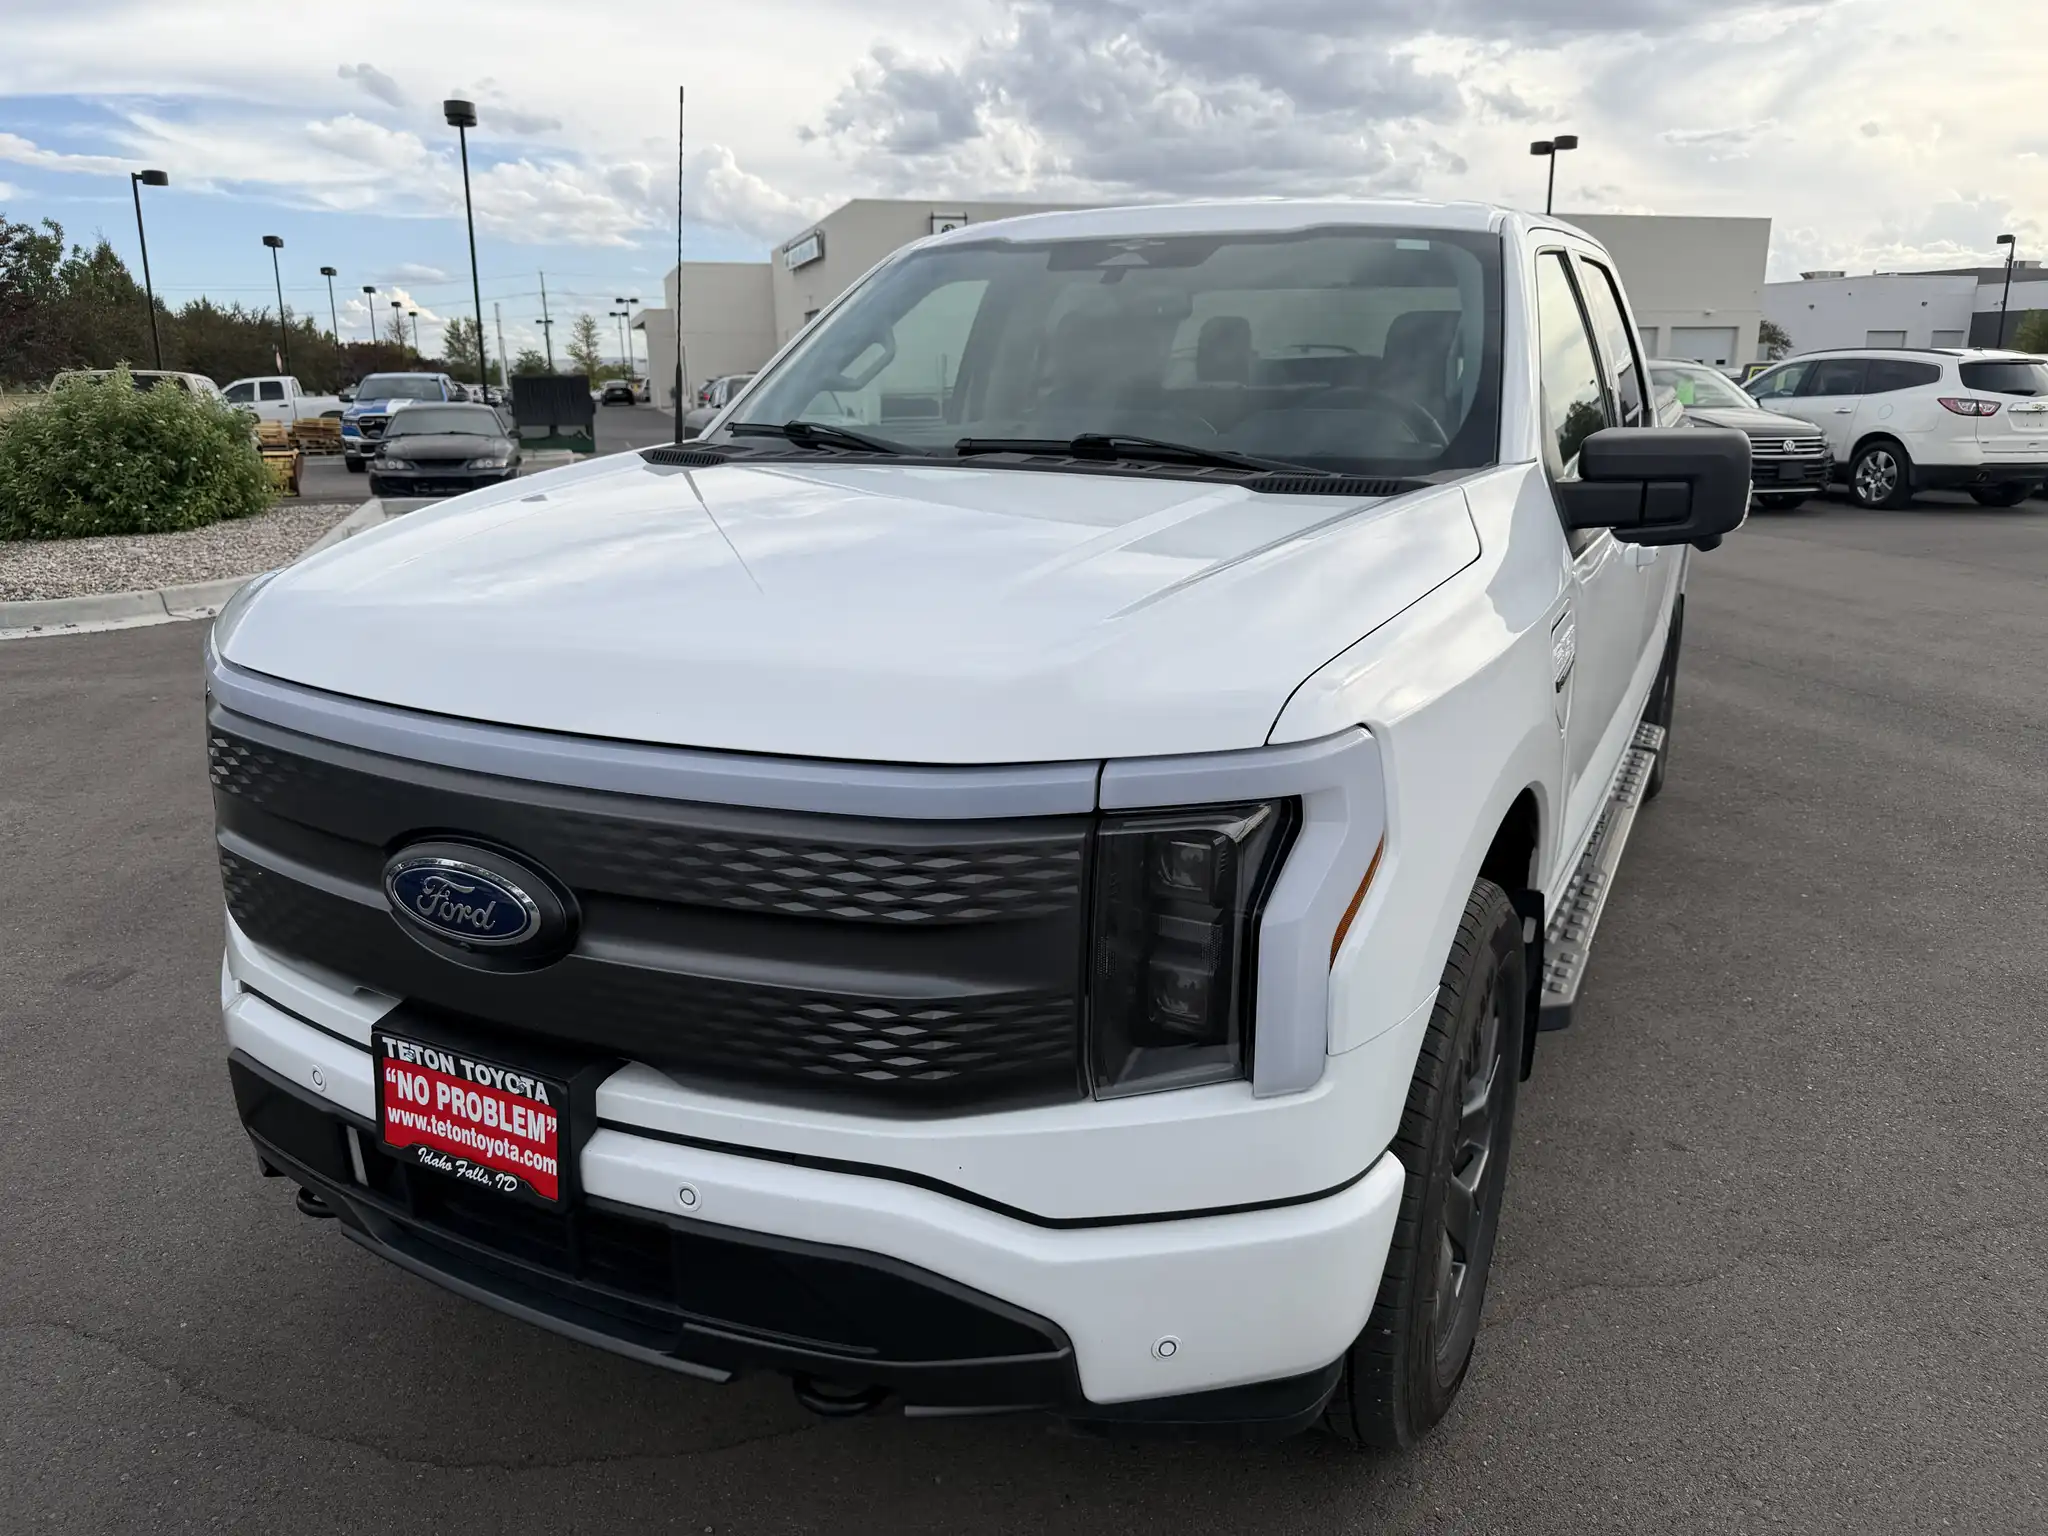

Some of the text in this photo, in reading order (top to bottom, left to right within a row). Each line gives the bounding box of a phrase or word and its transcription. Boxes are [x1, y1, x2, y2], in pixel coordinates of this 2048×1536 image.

[417, 876, 496, 930] Ford
[382, 1036, 550, 1105] TETON TOYOTA
[387, 1106, 557, 1176] www.tetontoyota.com
[418, 1147, 518, 1192] Idaho Falls, ID
